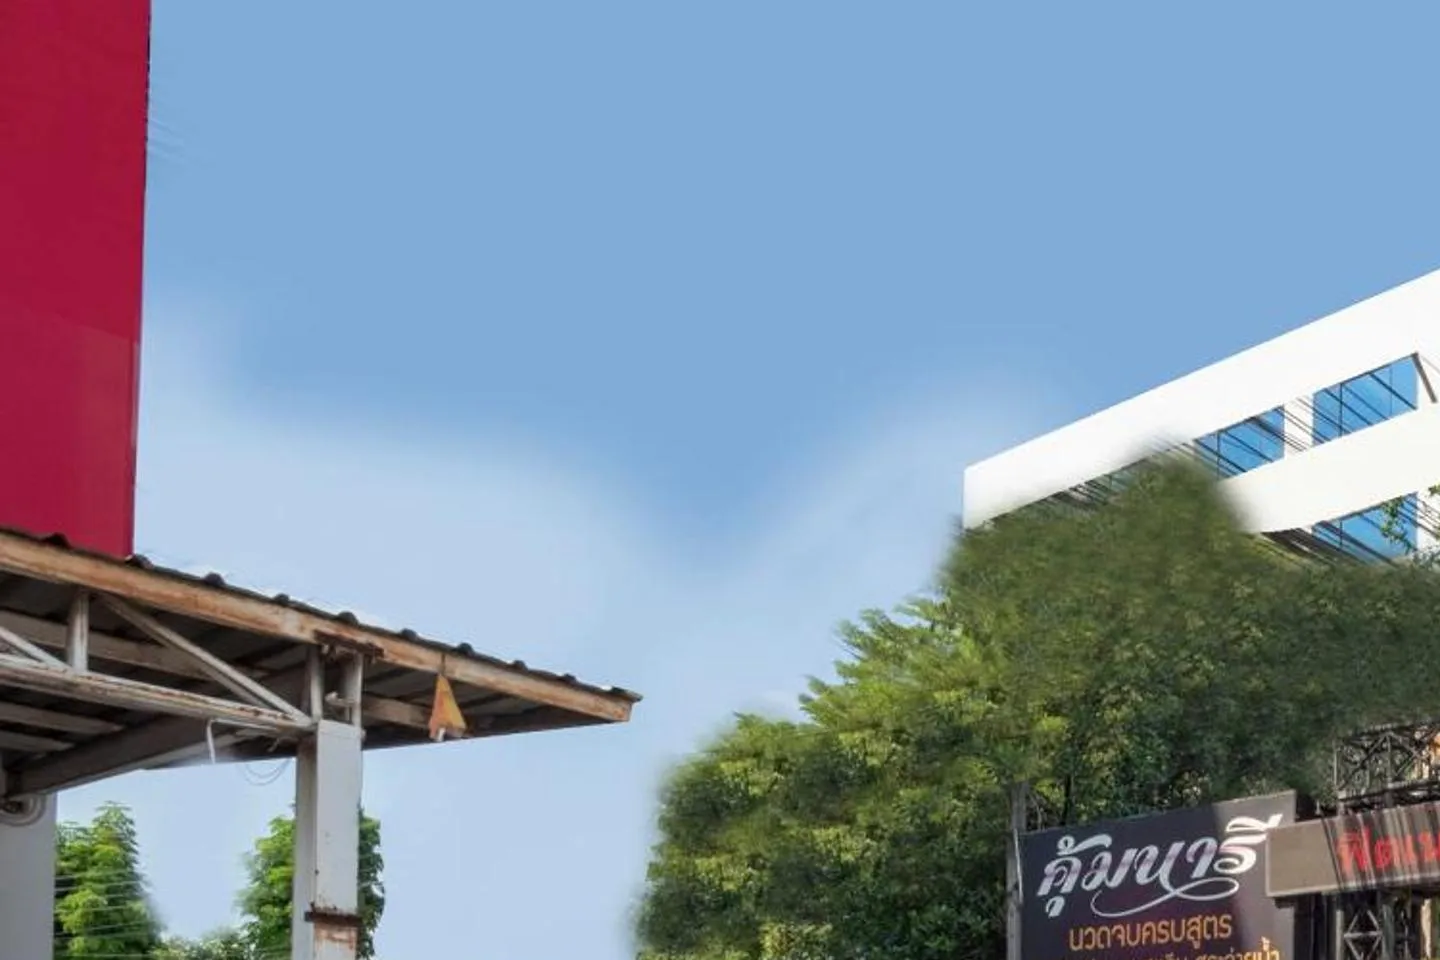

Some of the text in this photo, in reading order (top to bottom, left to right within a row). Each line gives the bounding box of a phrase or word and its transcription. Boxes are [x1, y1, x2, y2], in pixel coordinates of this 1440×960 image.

[1036, 813, 1284, 918] คุ้มนารี
[1069, 914, 1233, 950] นวดจบครบสูตร
